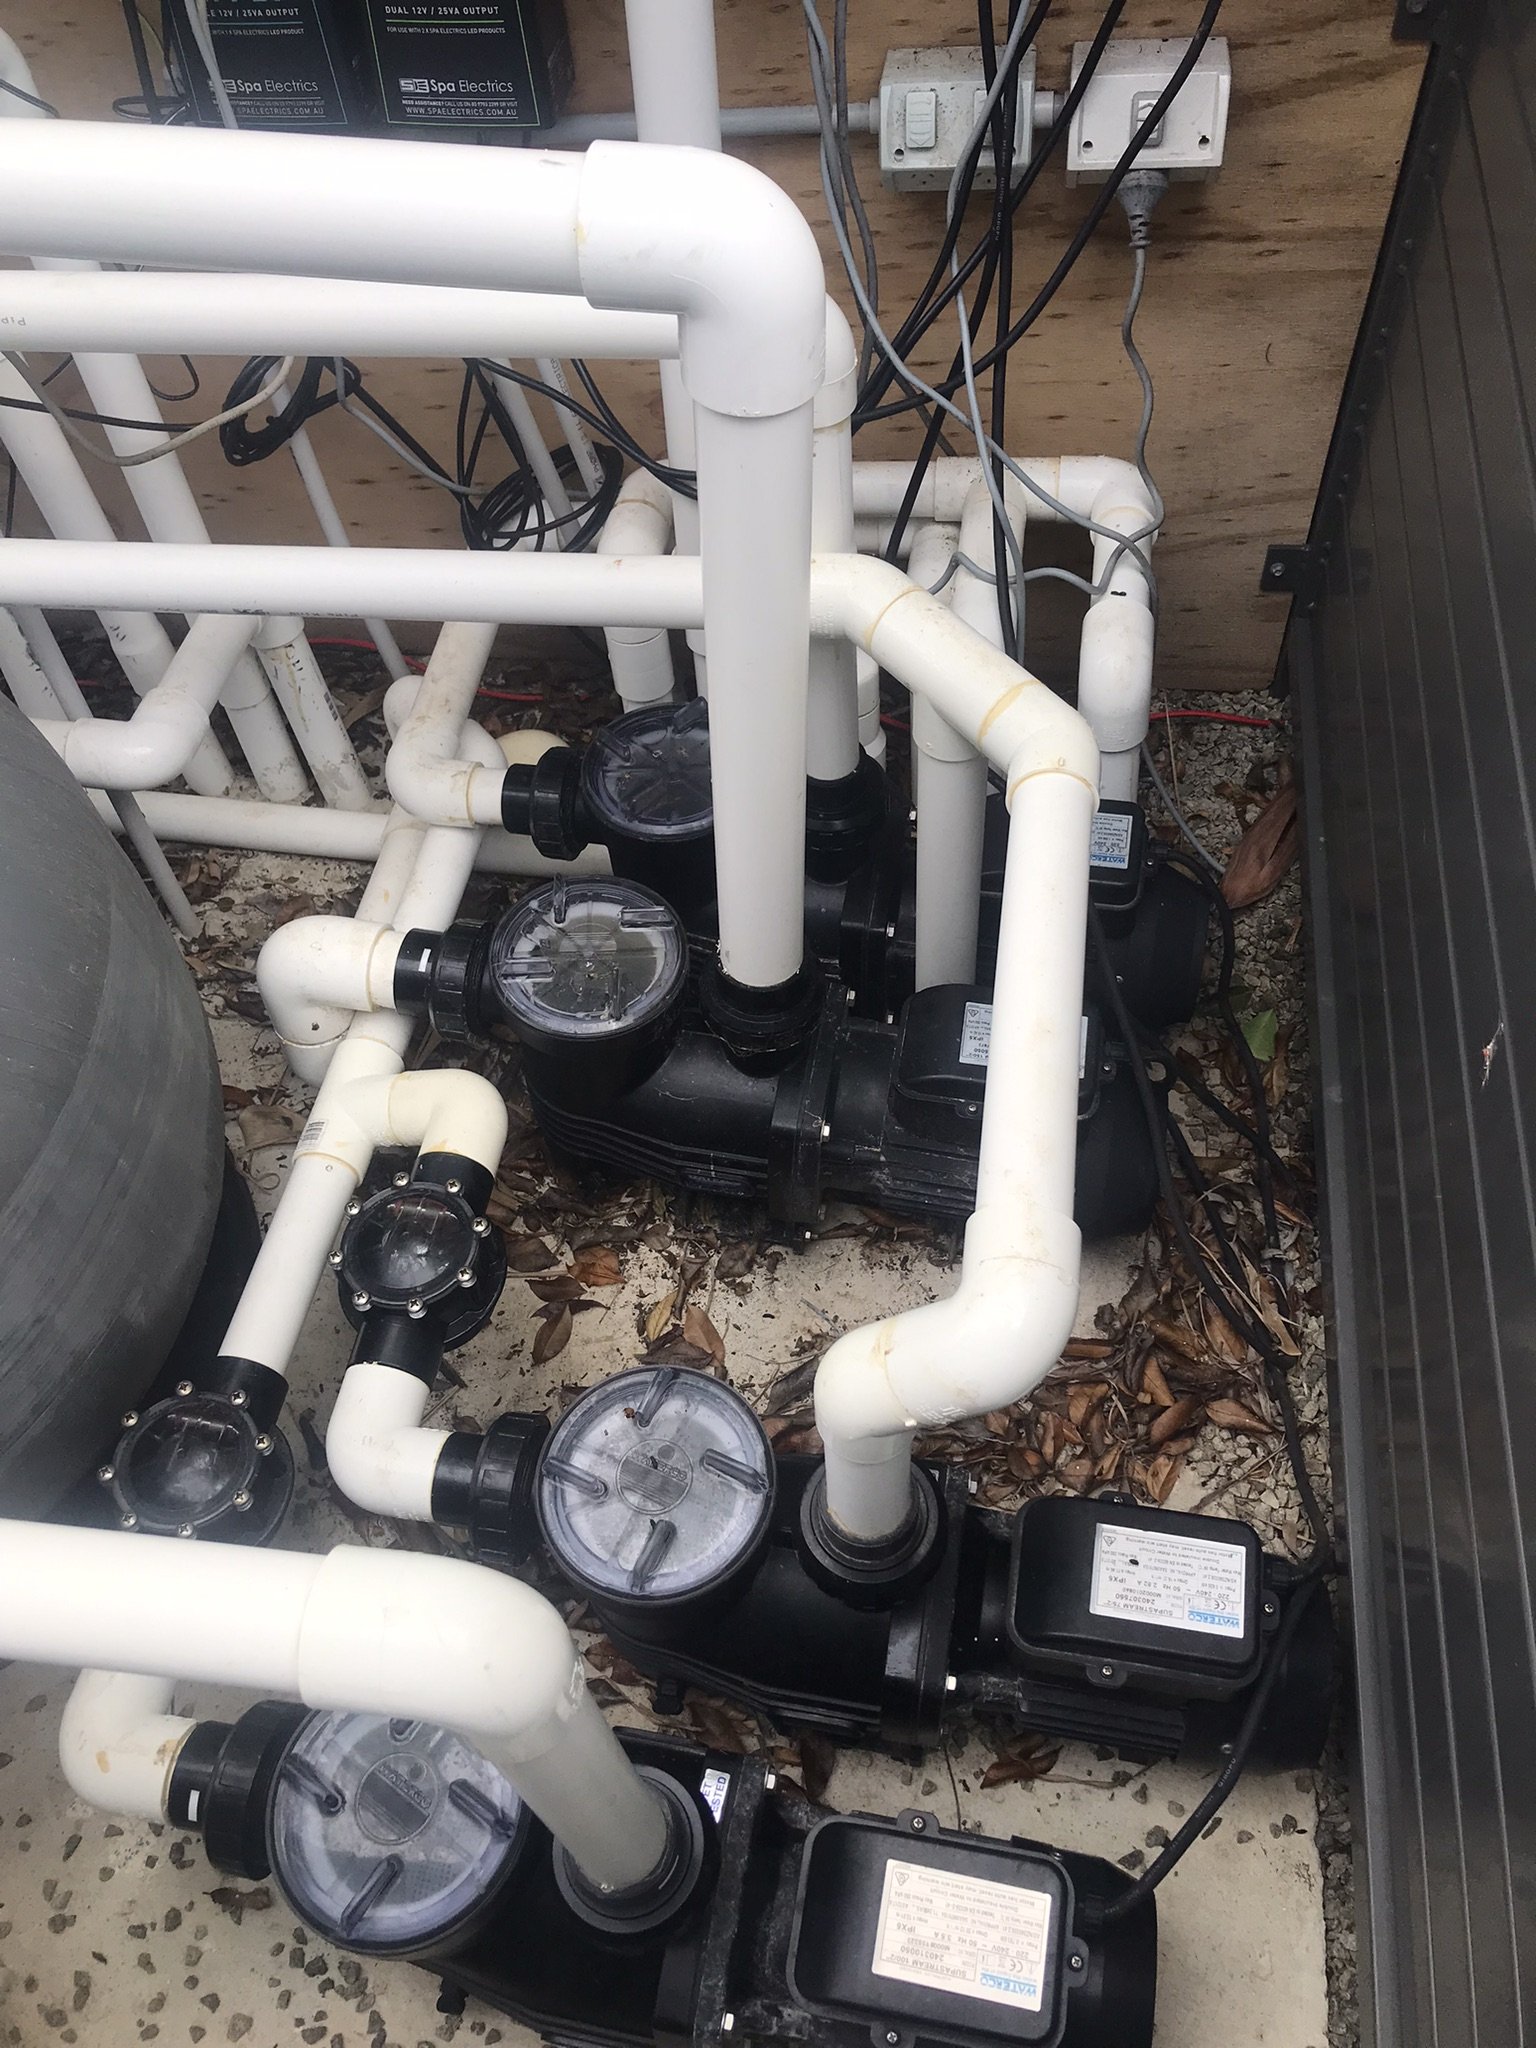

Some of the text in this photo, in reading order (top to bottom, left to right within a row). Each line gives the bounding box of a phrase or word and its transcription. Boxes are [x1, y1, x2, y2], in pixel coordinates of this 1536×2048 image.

[219, 8, 233, 17] 12V
[242, 8, 263, 17] 25VA
[265, 7, 300, 17] OUTPUT
[384, 5, 410, 15] DUAL
[411, 6, 427, 15] 12V
[438, 7, 461, 15] 25VA
[463, 6, 500, 15] OUTPUT
[237, 79, 263, 95] Spa
[264, 79, 320, 93] Electrics
[430, 78, 456, 95] Spa
[459, 79, 514, 93] Electrics
[1122, 1602, 1172, 1616] SUPASTREAM
[1187, 1612, 1239, 1628] WATERCO
[711, 1776, 727, 1813] ESTED
[911, 1958, 966, 1978] SUPASTREAM
[979, 1975, 1036, 1997] WATERCO
